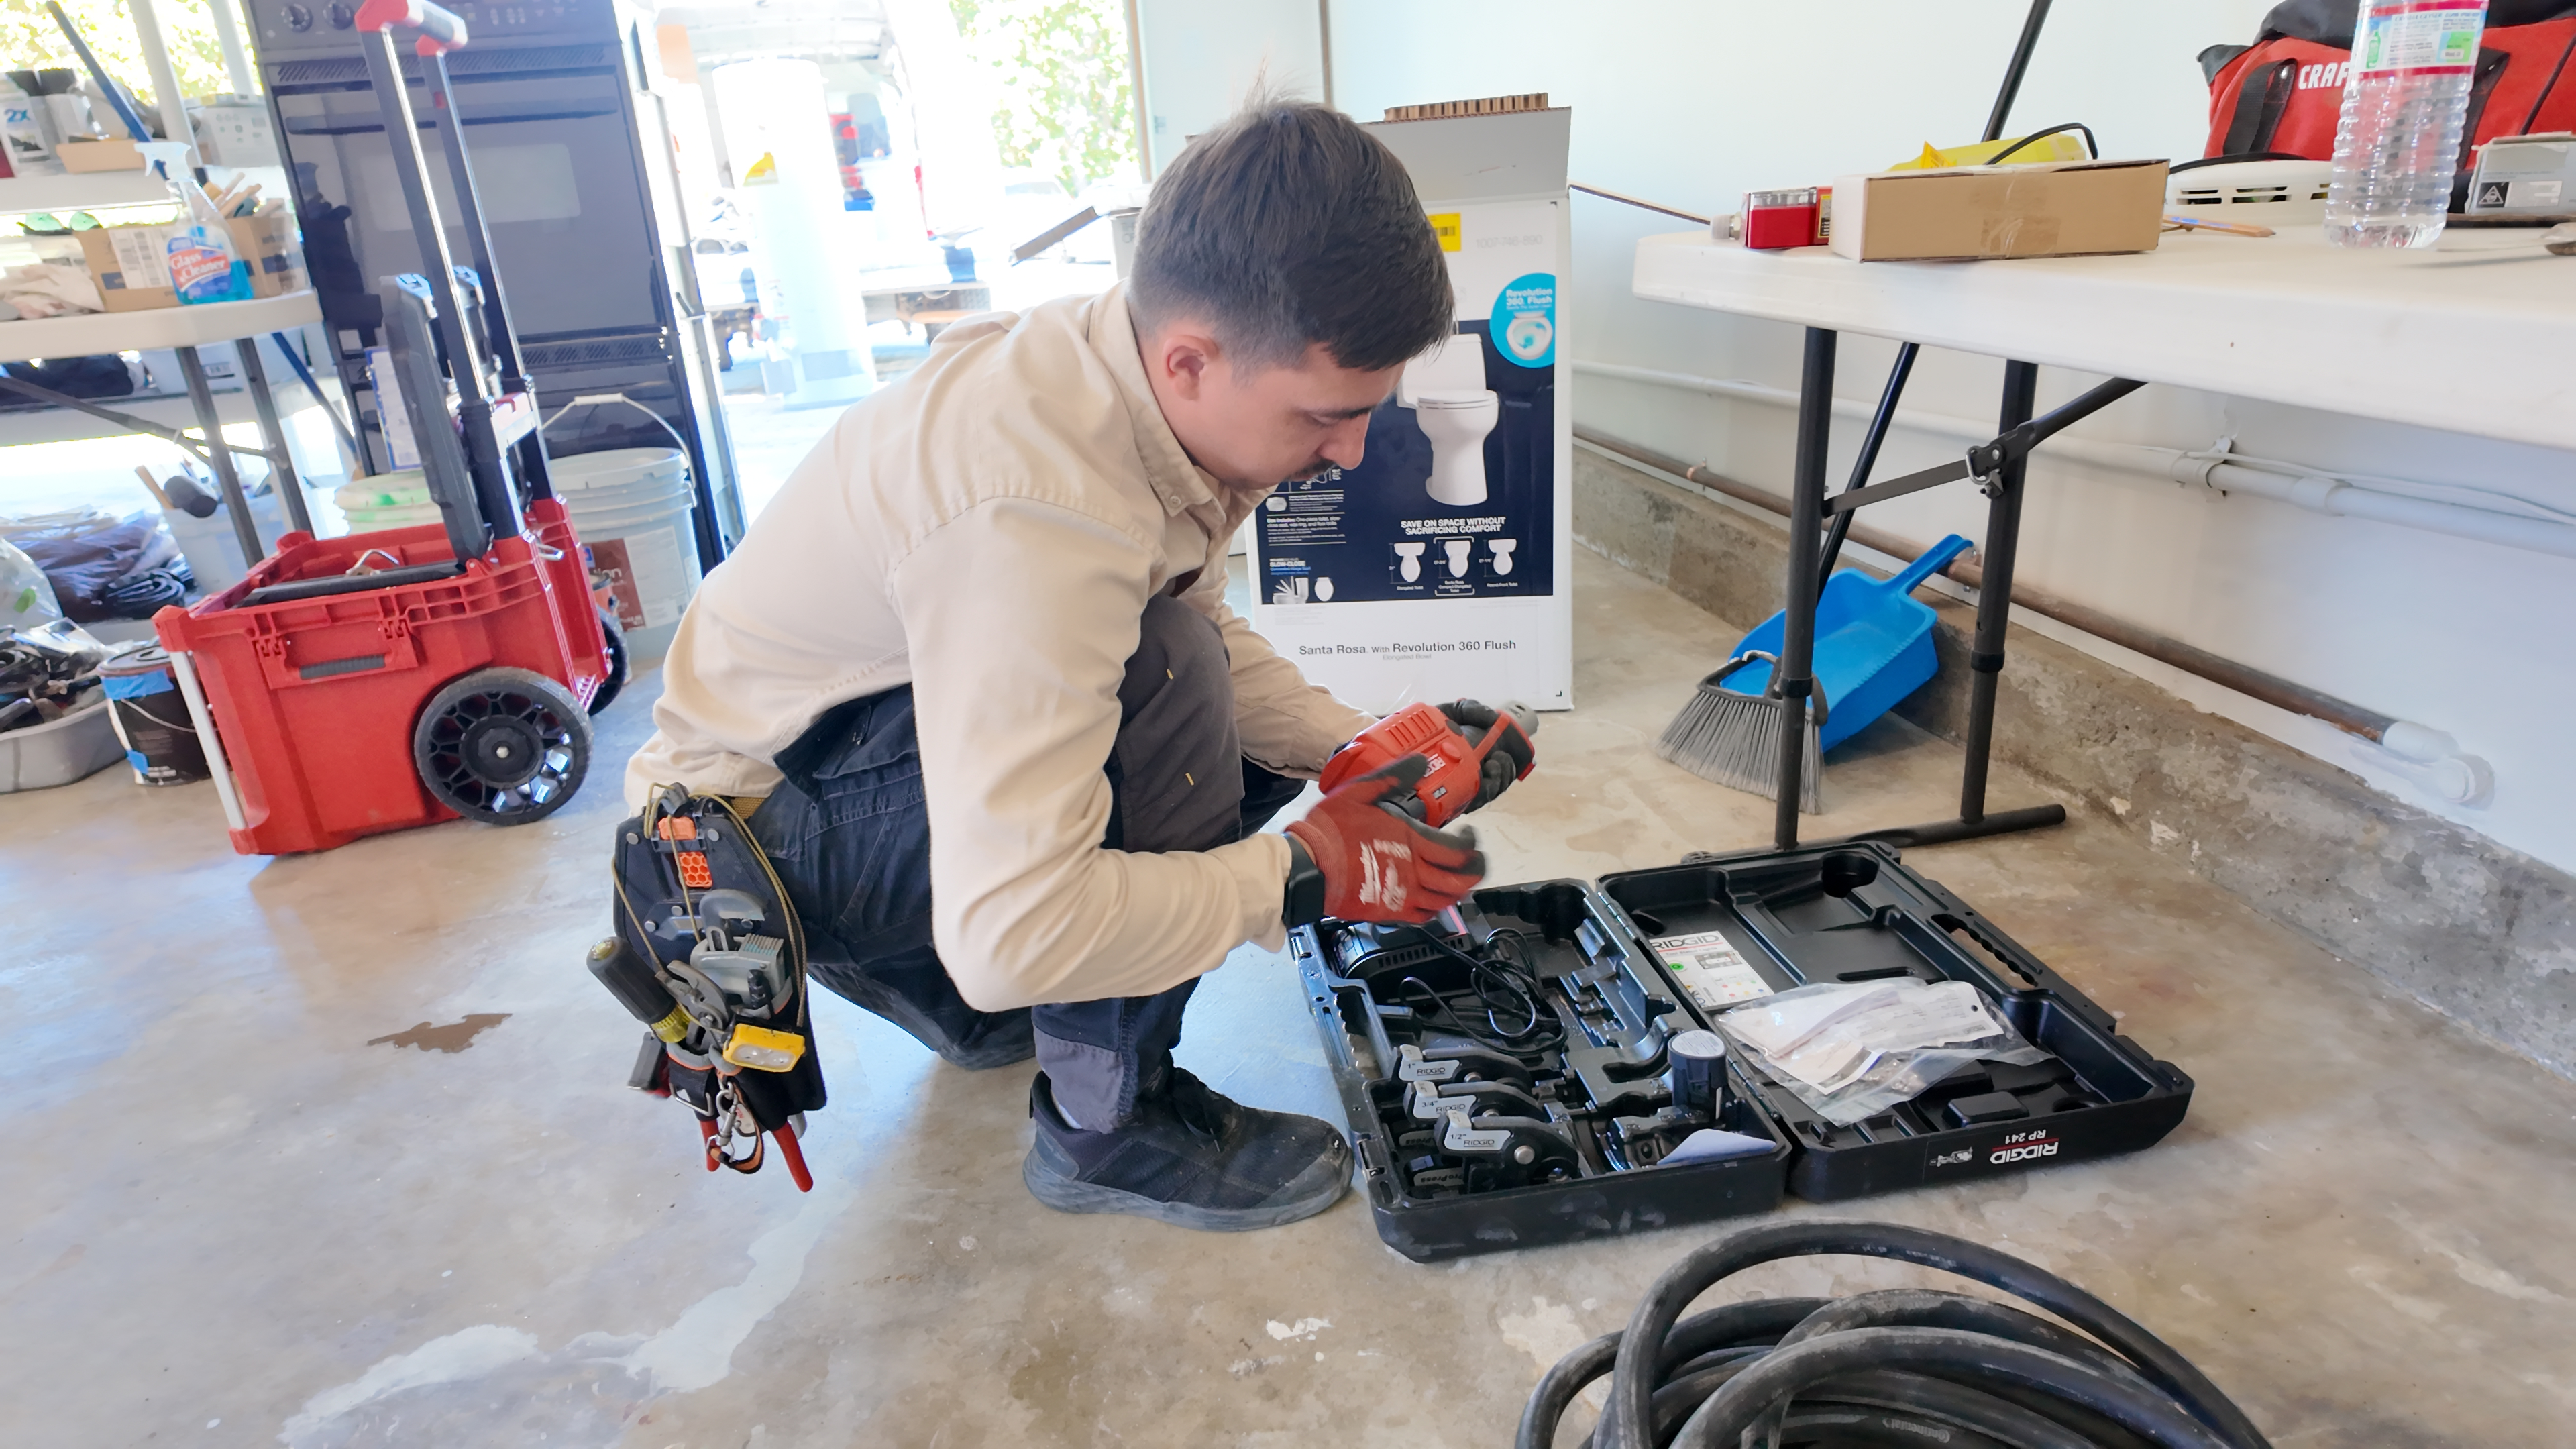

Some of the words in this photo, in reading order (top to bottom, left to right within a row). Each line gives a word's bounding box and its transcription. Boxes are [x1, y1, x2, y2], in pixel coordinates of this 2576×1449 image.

[171, 254, 201, 270] Glass
[182, 260, 225, 279] Cleaner
[1506, 288, 1553, 297] Revolution
[1527, 295, 1552, 304] Flush
[1401, 520, 1423, 528] SAVE
[1424, 519, 1436, 527] ON
[1438, 519, 1465, 527] SPACE
[1466, 517, 1506, 525] WITHOUT
[1405, 525, 1458, 535] SACRIFICING
[1460, 524, 1501, 533] COMFORT
[1299, 645, 1333, 655] Santa
[1336, 645, 1366, 654] Rosa
[1393, 641, 1455, 653] Revolution
[1458, 641, 1480, 651] 360
[1485, 640, 1516, 650] Flush
[1650, 935, 1719, 949] RIDGID
[1436, 1104, 1466, 1112] RIDGID
[2005, 1132, 2026, 1144] 241
[2028, 1129, 2046, 1140] RP
[1990, 1142, 2059, 1164] RIDGID
[1891, 1419, 1951, 1444] Continental
